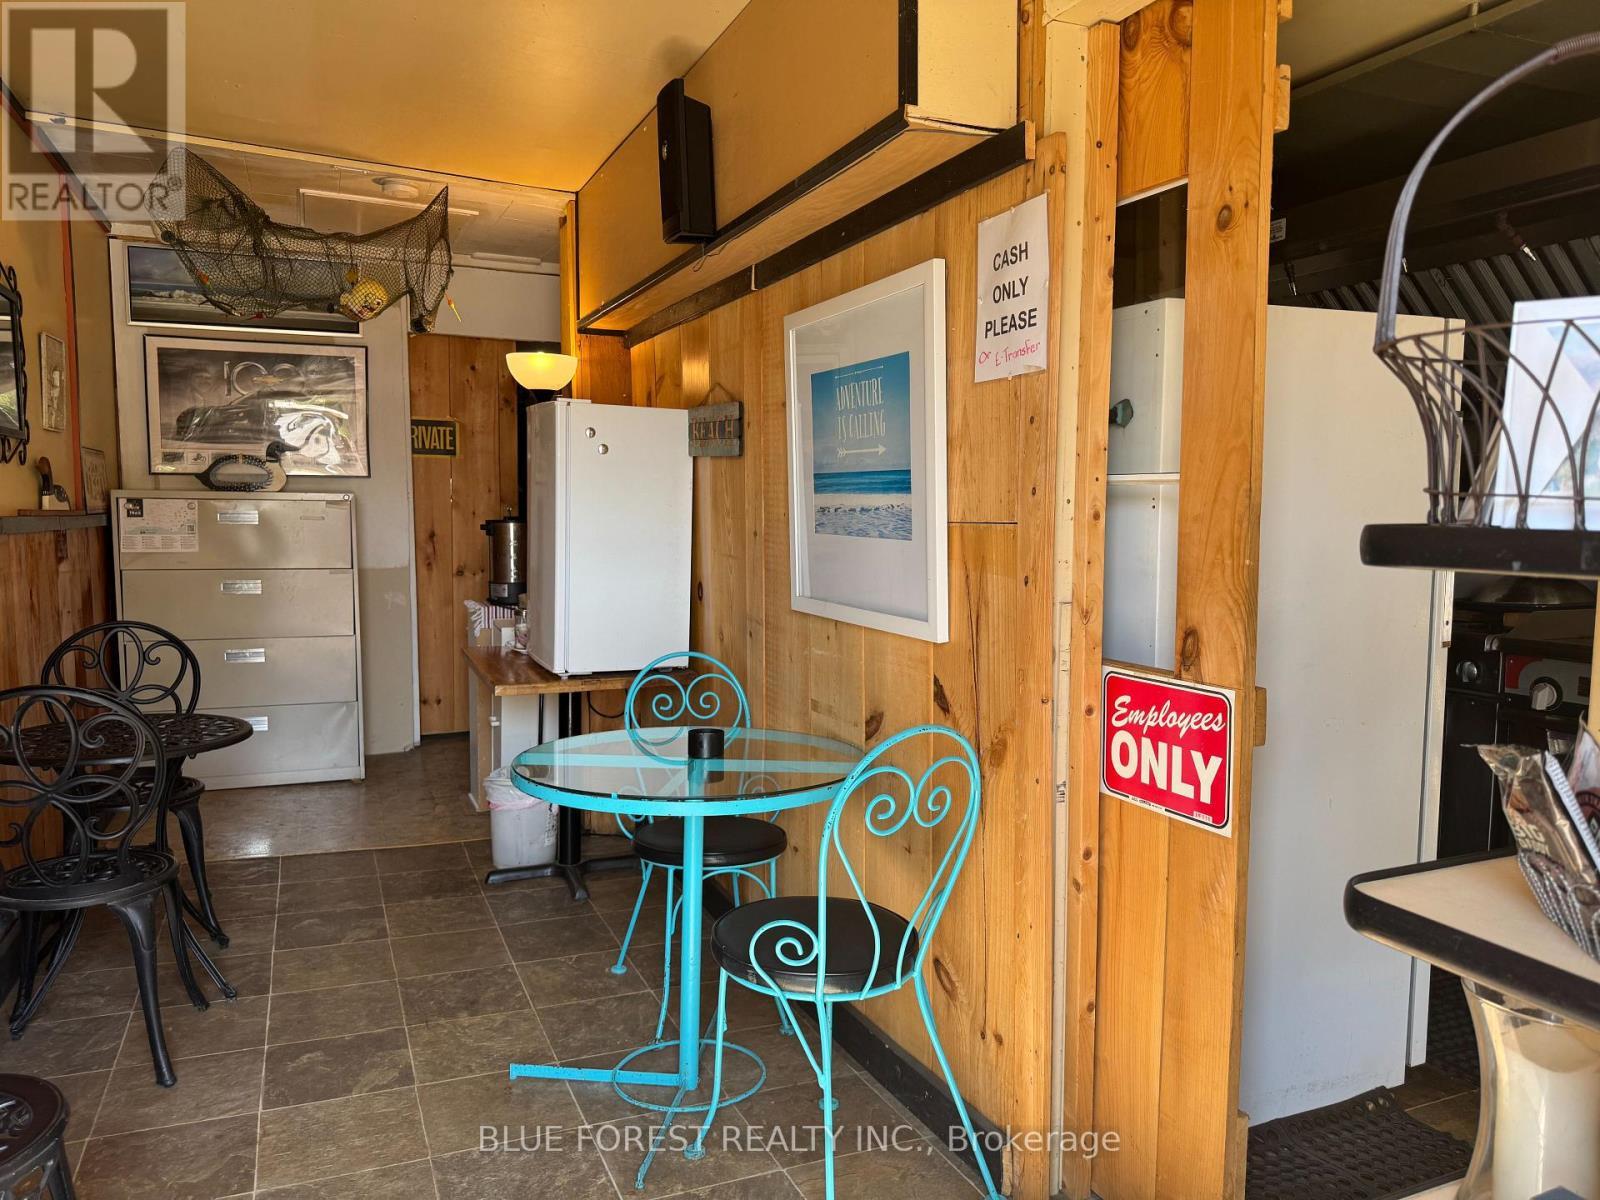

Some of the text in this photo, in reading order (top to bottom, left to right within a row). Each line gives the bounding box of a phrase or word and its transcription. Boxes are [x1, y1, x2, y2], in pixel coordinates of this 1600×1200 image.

[992, 241, 1029, 272] CASH
[992, 276, 1029, 304] ONLY
[984, 308, 1038, 339] PLEASE
[836, 376, 884, 411] ADVENTURE
[411, 425, 455, 450] RIVATE
[837, 409, 886, 443] IS CALLING
[1111, 695, 1226, 739] Employees
[1111, 730, 1223, 805] ONLY
